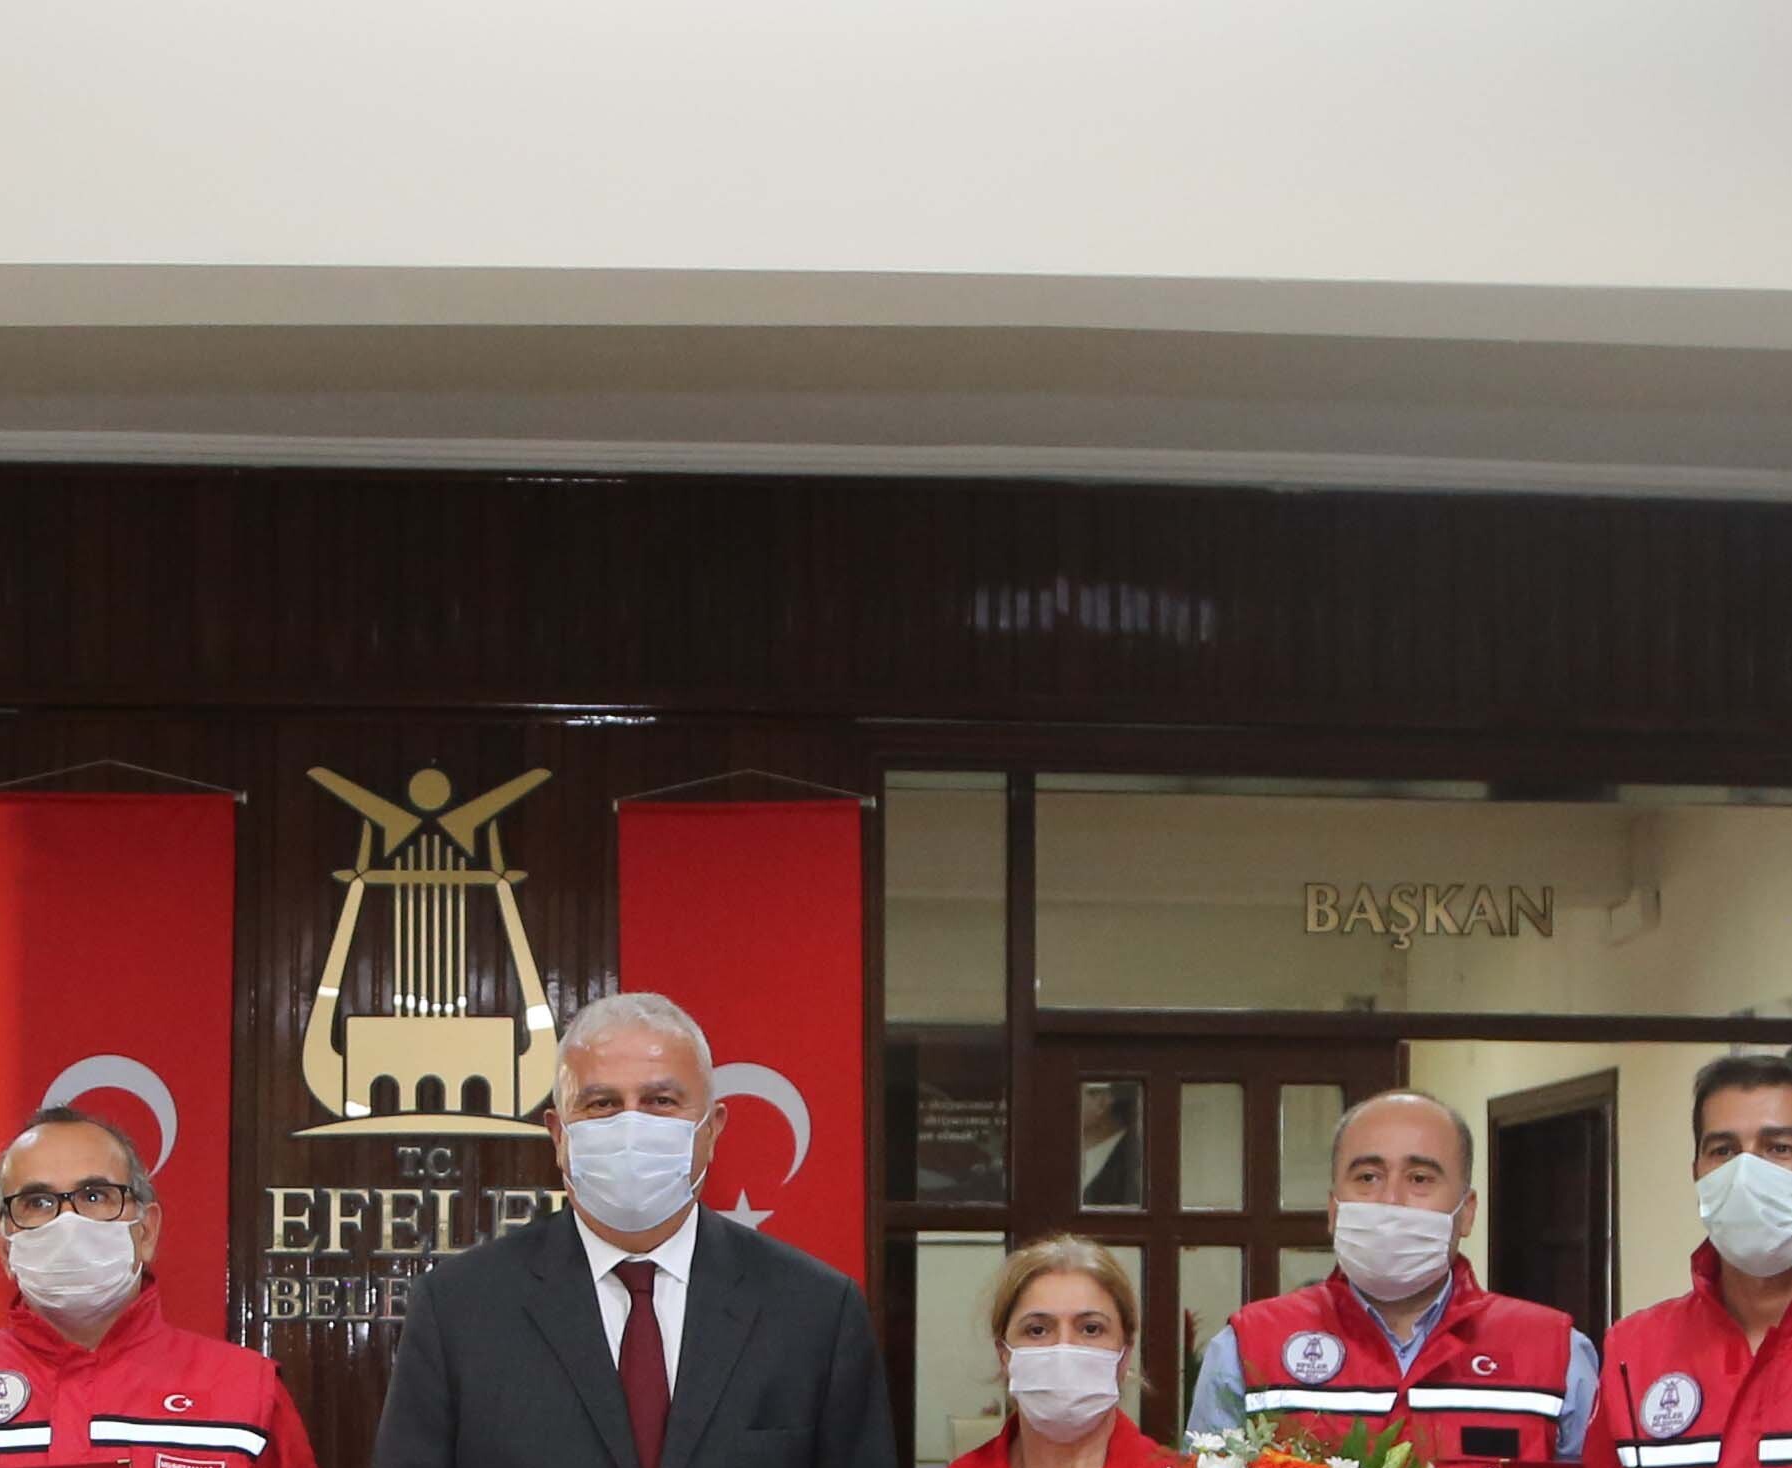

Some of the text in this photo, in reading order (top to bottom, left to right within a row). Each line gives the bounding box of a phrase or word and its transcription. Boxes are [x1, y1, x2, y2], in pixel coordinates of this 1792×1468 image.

[1304, 882, 1554, 949] BAŞKAN
[396, 1146, 461, 1176] T.C.
[264, 1186, 569, 1255] EFELE
[265, 1276, 409, 1320] BELE
